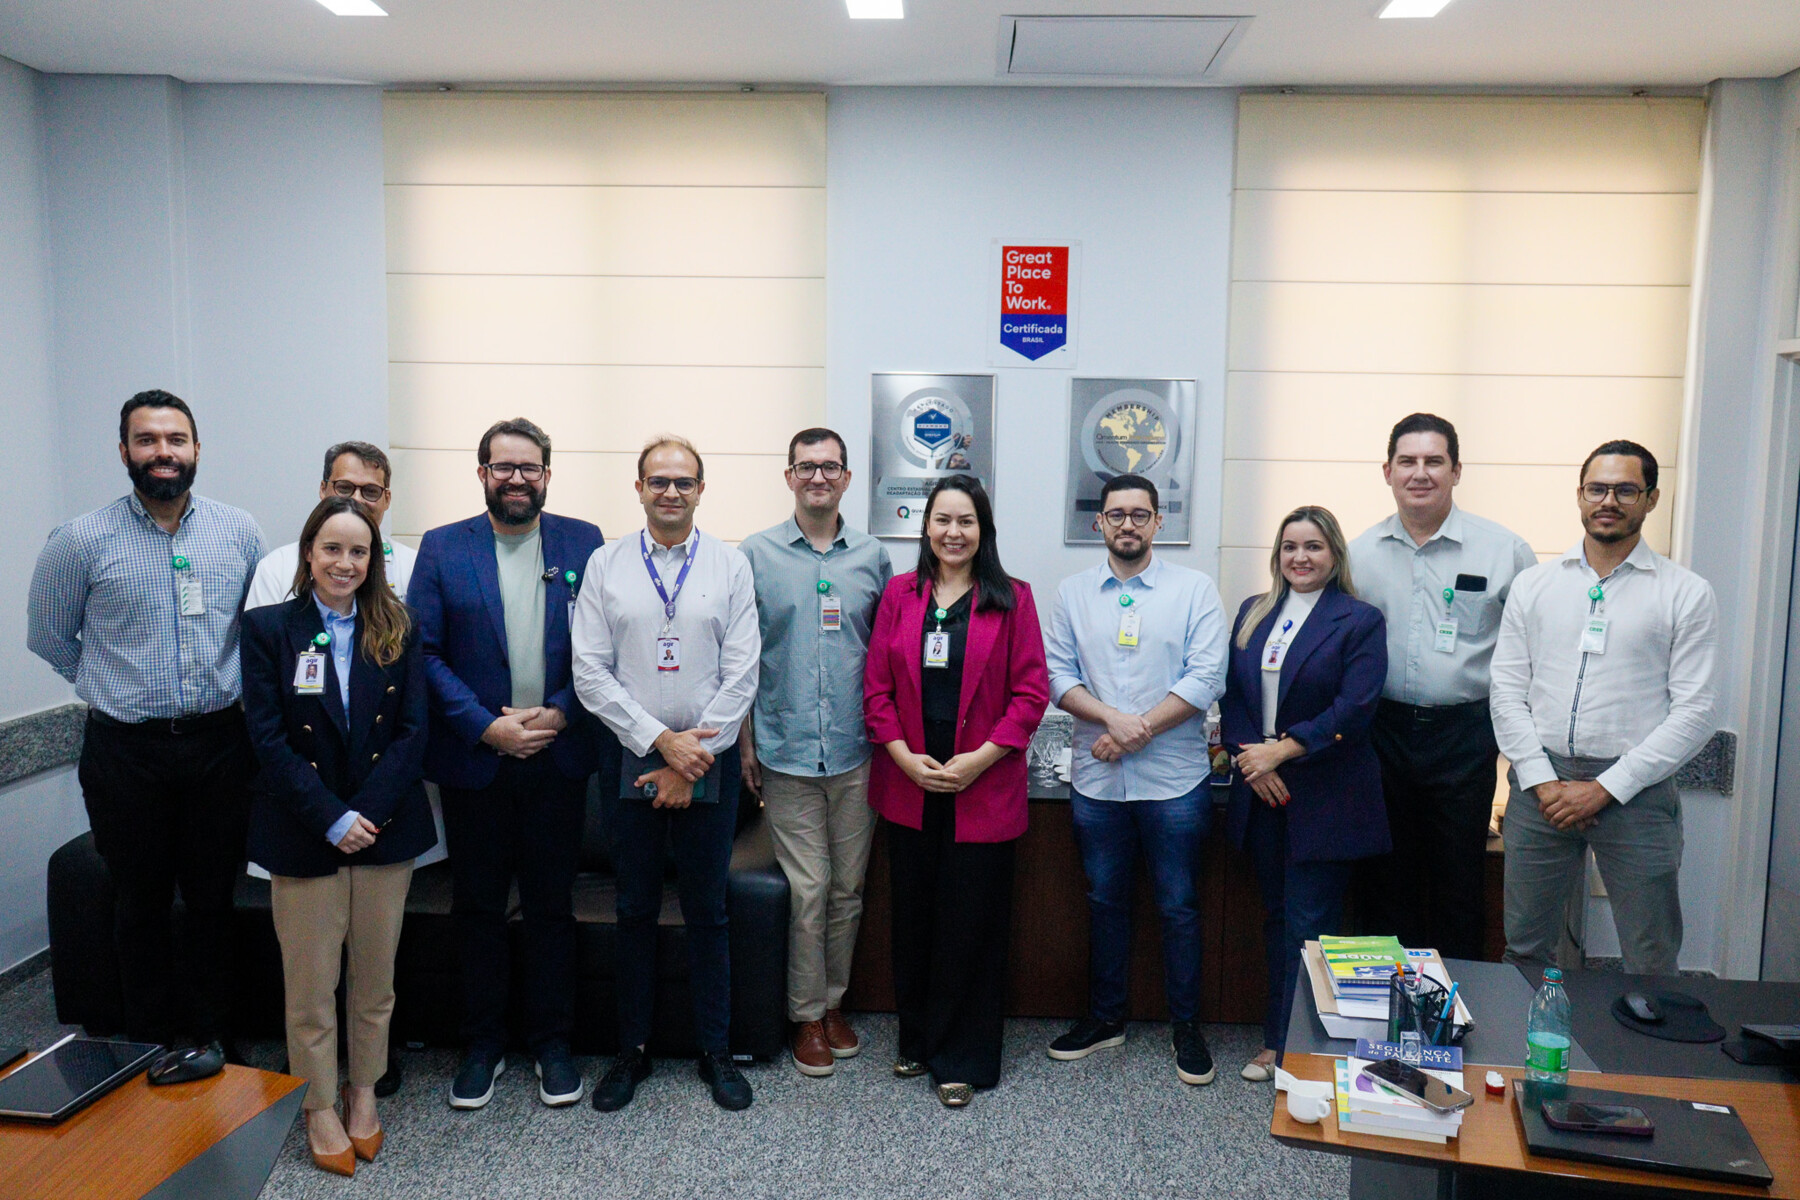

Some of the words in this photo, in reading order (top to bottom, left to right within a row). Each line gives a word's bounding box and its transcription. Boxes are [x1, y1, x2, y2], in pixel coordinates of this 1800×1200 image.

[1006, 250, 1052, 264] Great
[1007, 265, 1051, 279] Place
[1006, 281, 1023, 294] To
[1003, 323, 1063, 334] Certificada
[1105, 404, 1160, 420] MEMBERSHIP
